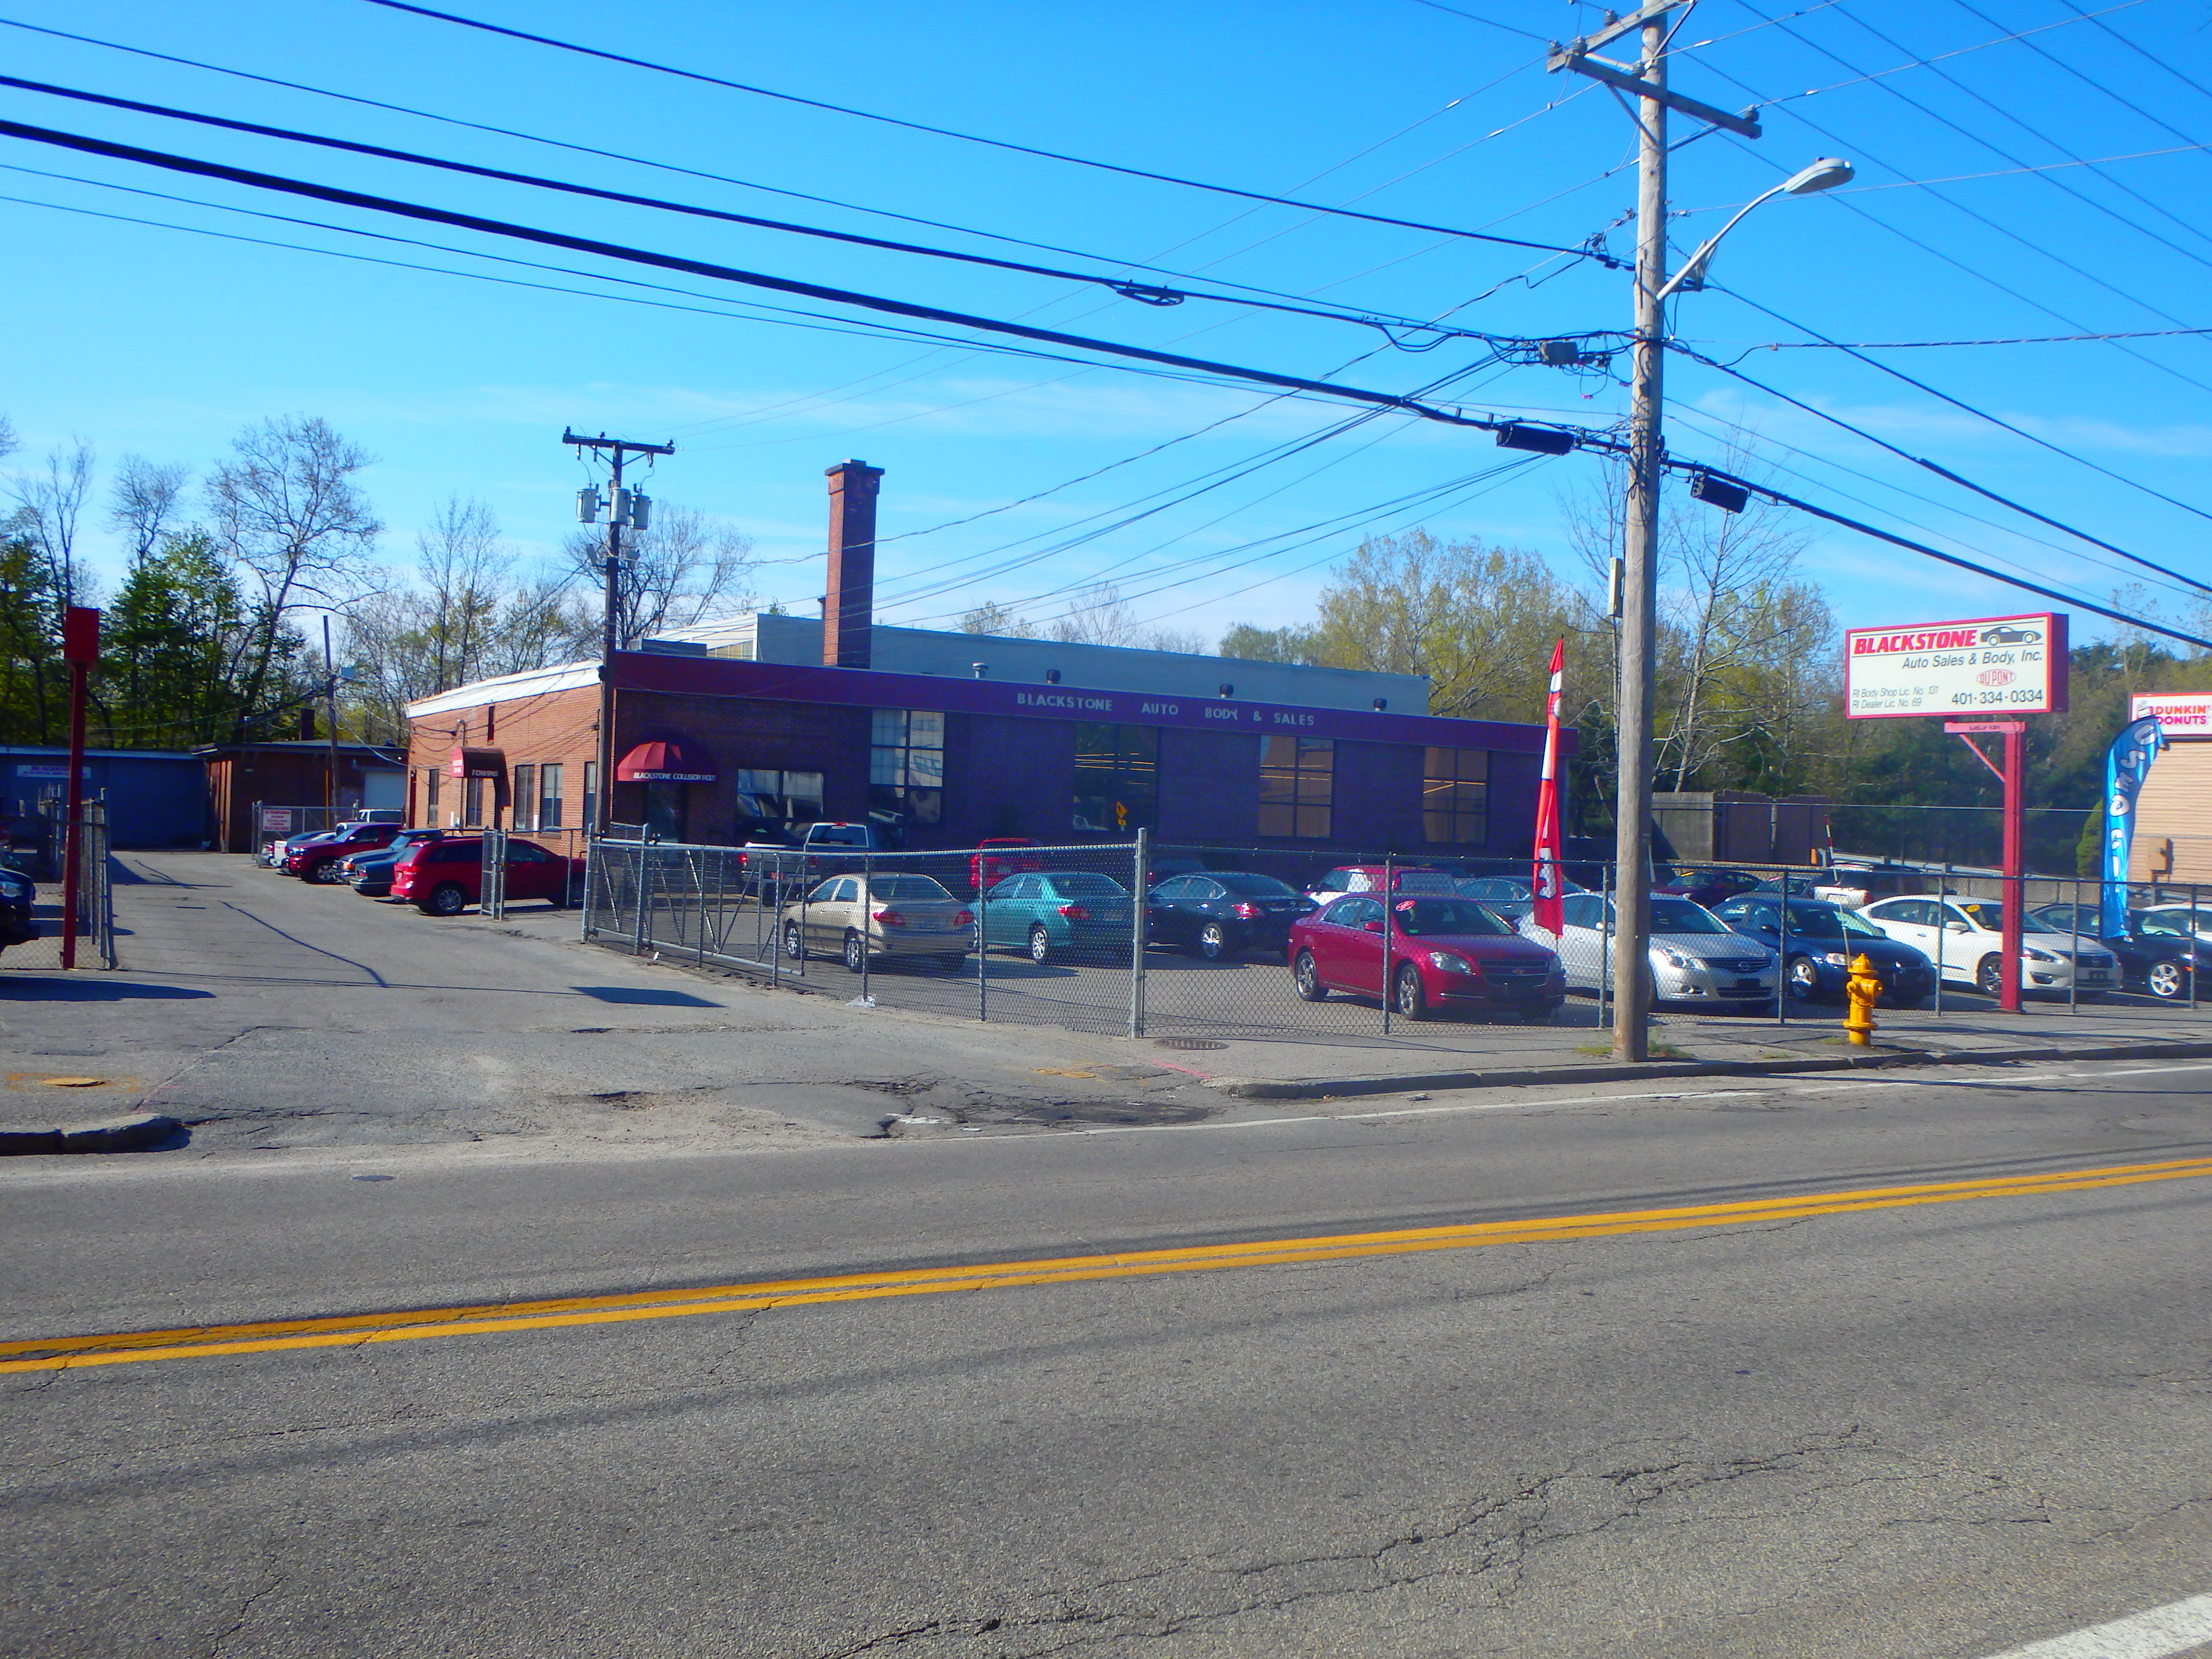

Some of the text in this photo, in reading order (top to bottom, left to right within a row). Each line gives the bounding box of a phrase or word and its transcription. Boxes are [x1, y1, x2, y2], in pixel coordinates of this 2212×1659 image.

[1854, 630, 1977, 654] BLACKSTONE
[1902, 649, 2042, 669] Auto Sales & Body, Inc.
[1861, 688, 1878, 698] Body
[1880, 688, 1897, 698] Shop
[1861, 699, 1883, 709] Dealer
[1017, 693, 1315, 726] BLACKSTONE AUTO BODY & SALES
[2155, 705, 2210, 715] DUNKIN'
[2157, 716, 2207, 724] DONUTS
